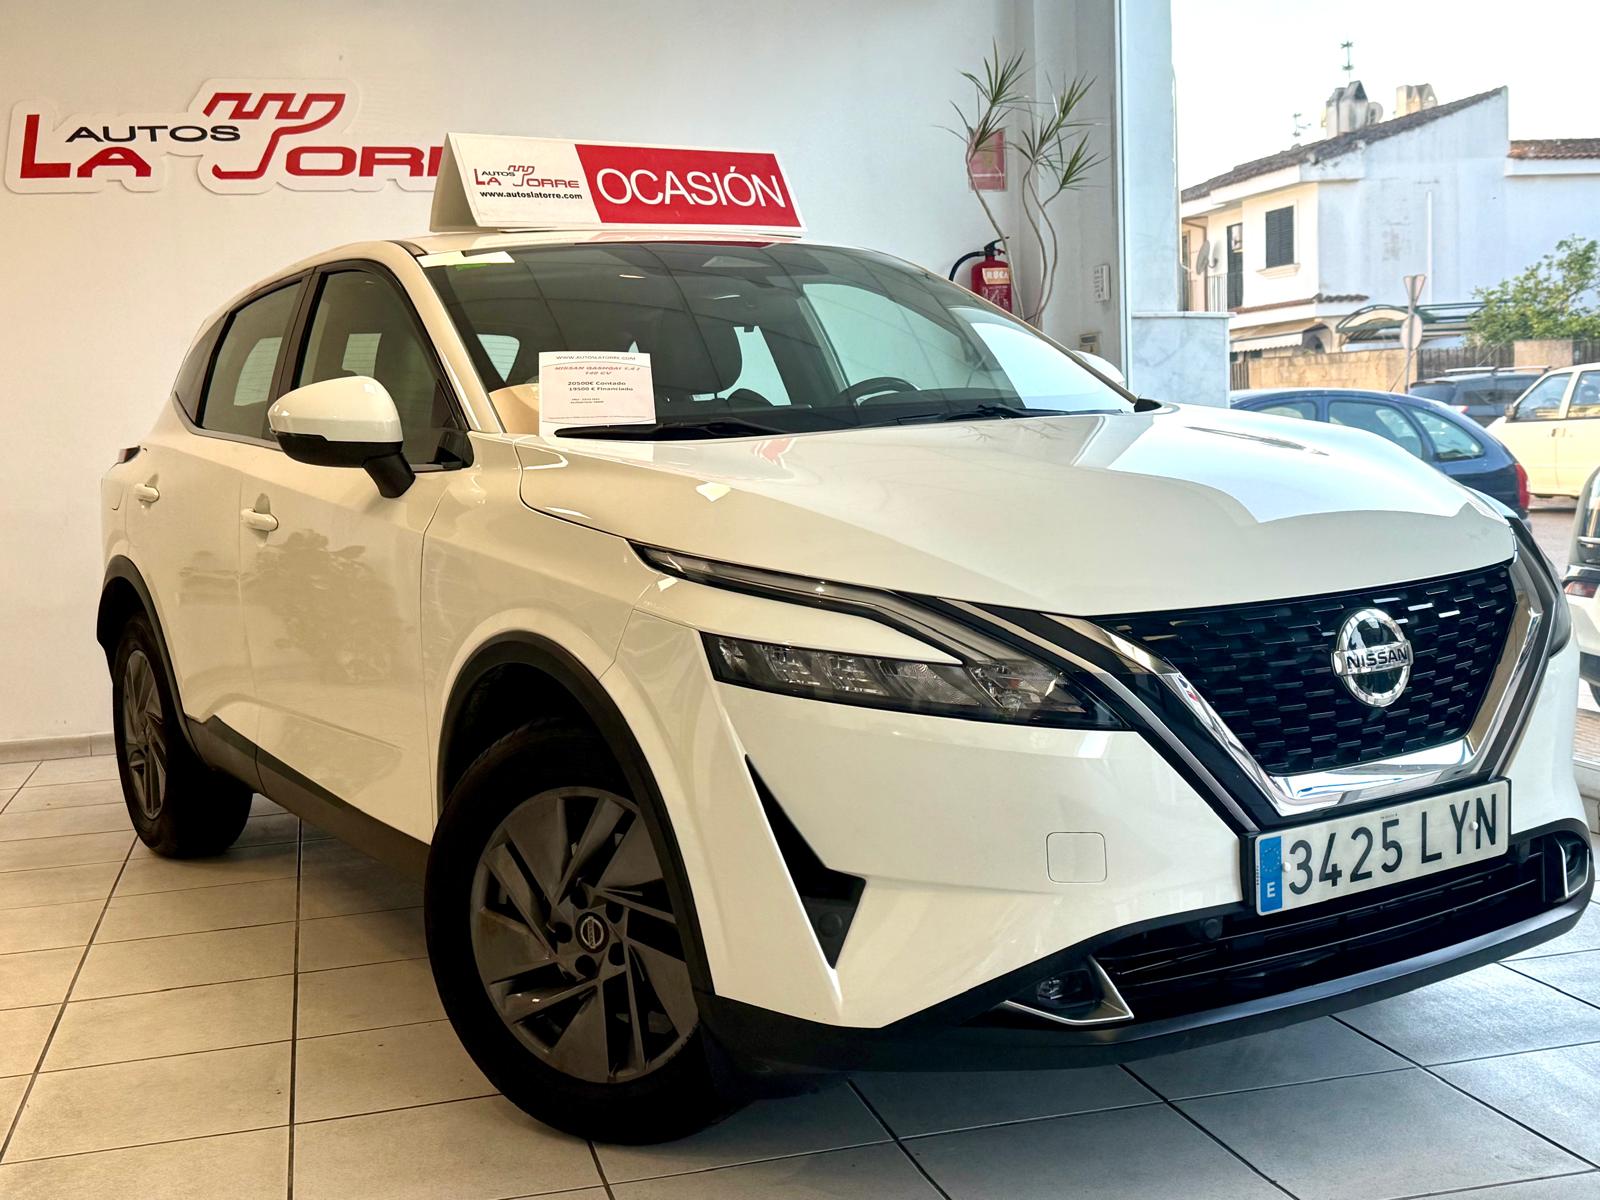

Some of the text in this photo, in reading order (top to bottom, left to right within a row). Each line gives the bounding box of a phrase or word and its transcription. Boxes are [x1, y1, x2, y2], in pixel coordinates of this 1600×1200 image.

[65, 125, 241, 143] AUTOS
[20, 114, 152, 179] LA
[473, 165, 580, 189] LA TORRE
[596, 165, 787, 208] OCASIÓN
[479, 191, 583, 200] www.autoslatorre.com
[1346, 647, 1408, 670] NISSAN
[1266, 793, 1497, 898] E 3425 LYN
